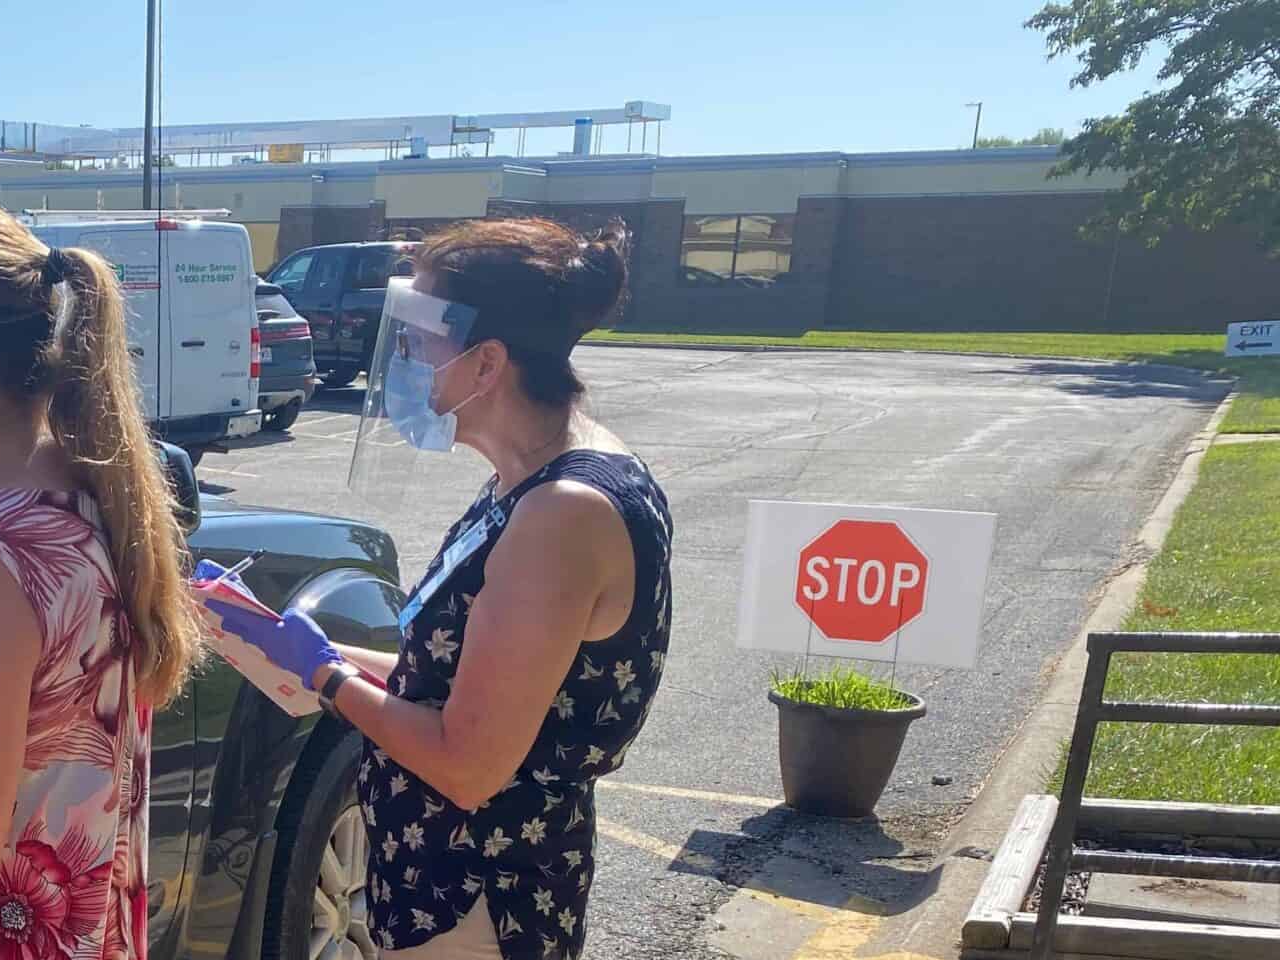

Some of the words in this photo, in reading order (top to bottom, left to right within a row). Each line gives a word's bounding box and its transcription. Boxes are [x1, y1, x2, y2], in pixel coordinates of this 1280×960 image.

[175, 263, 186, 272] 24
[188, 263, 207, 272] Hour
[1240, 324, 1272, 337] EXIT
[802, 555, 921, 607] STOP
